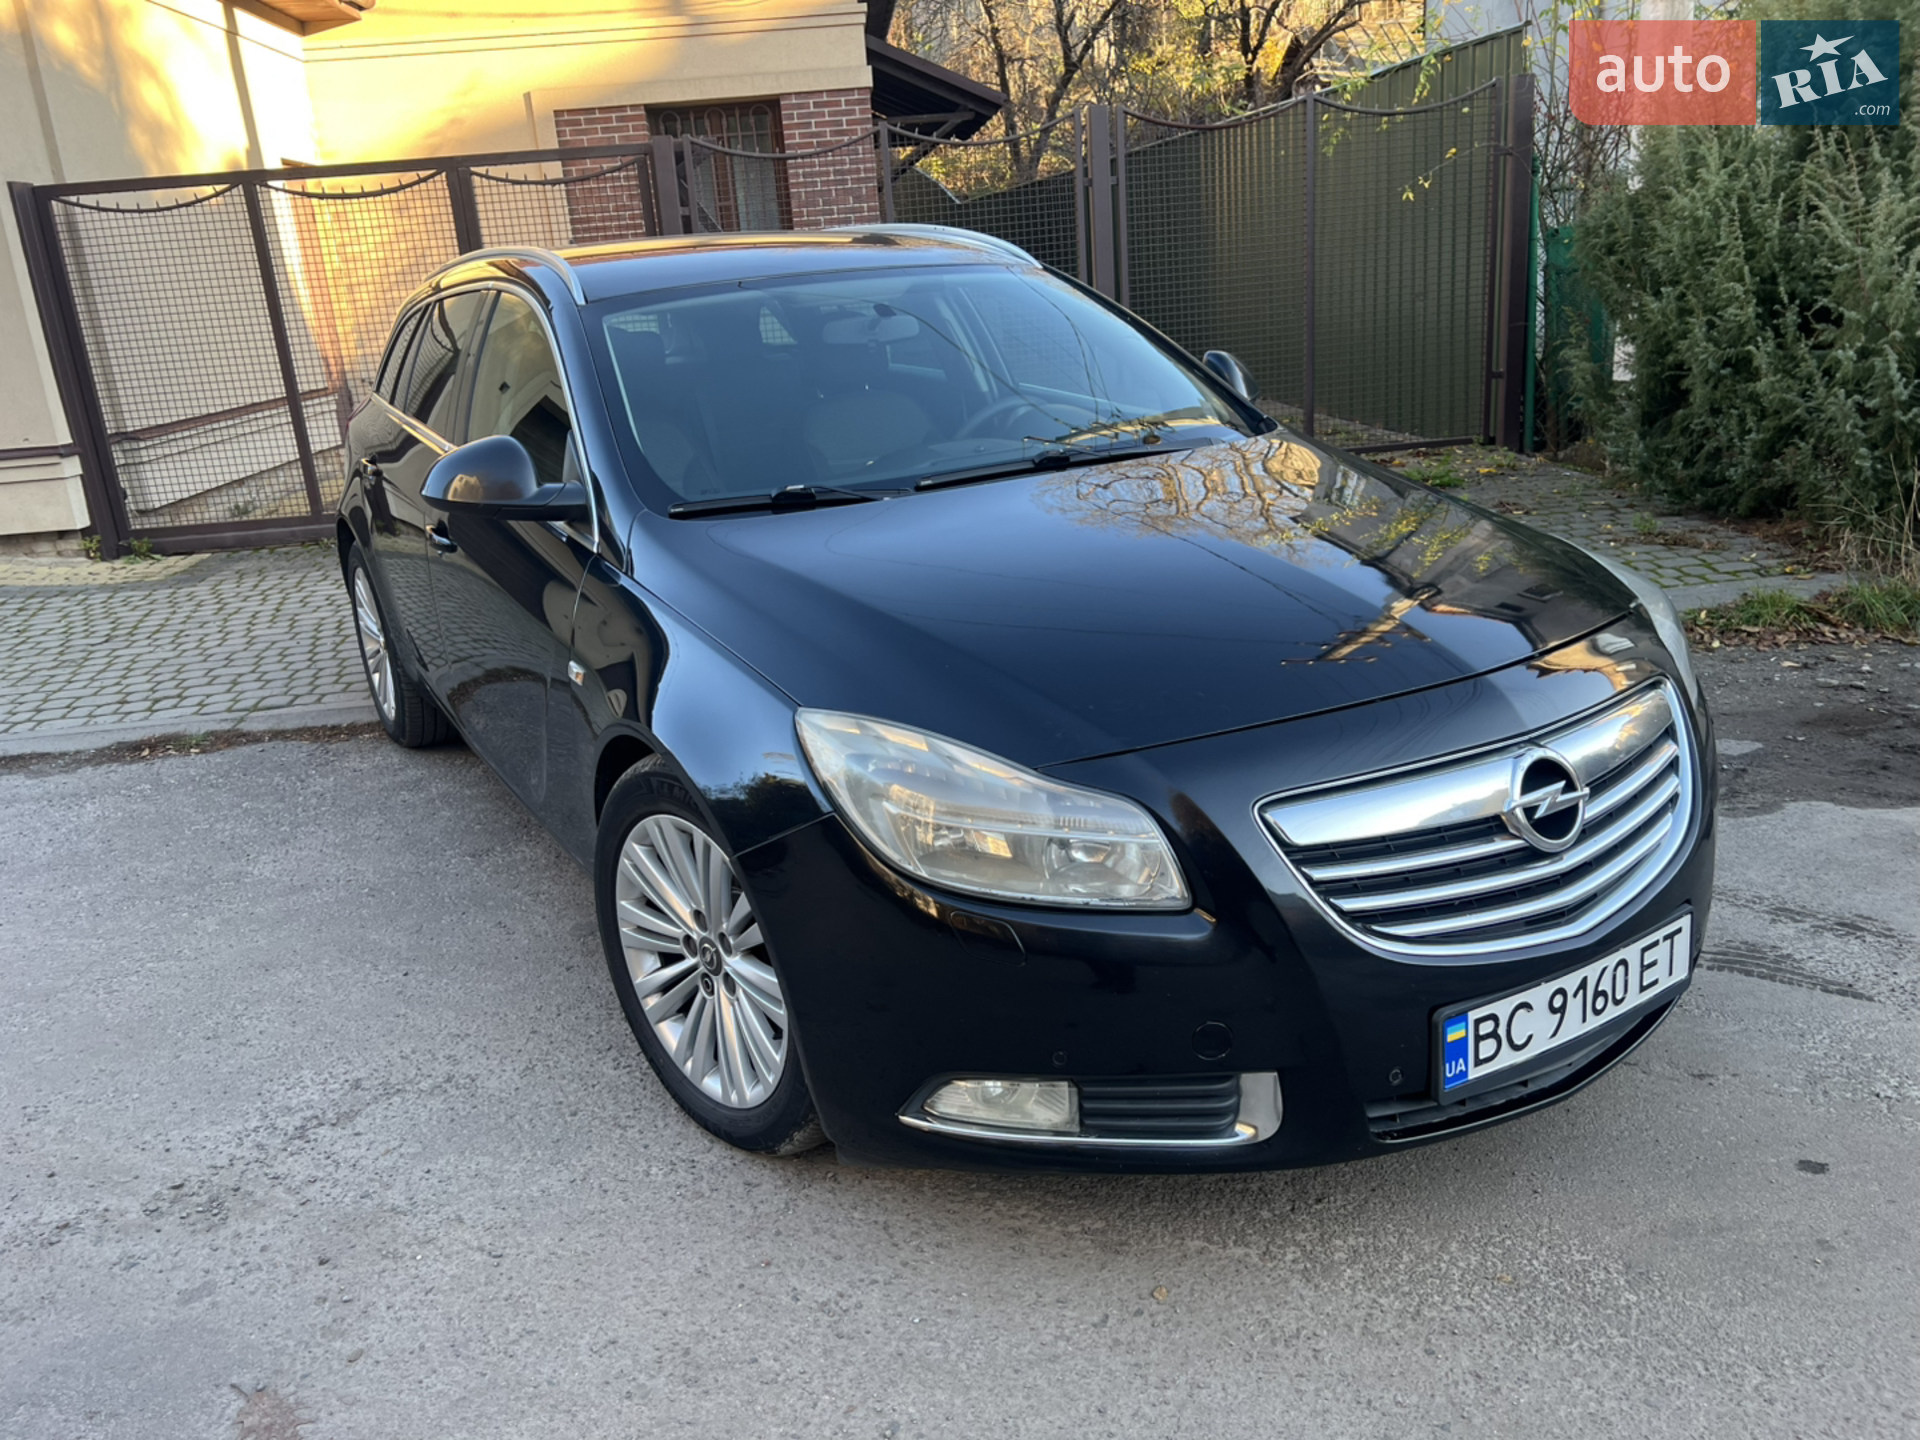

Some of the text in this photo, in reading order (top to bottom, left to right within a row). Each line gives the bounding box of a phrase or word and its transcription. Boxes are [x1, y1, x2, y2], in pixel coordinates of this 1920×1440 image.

[1473, 926, 1683, 1068] BC 9160 ET
[1445, 1057, 1467, 1078] UA
